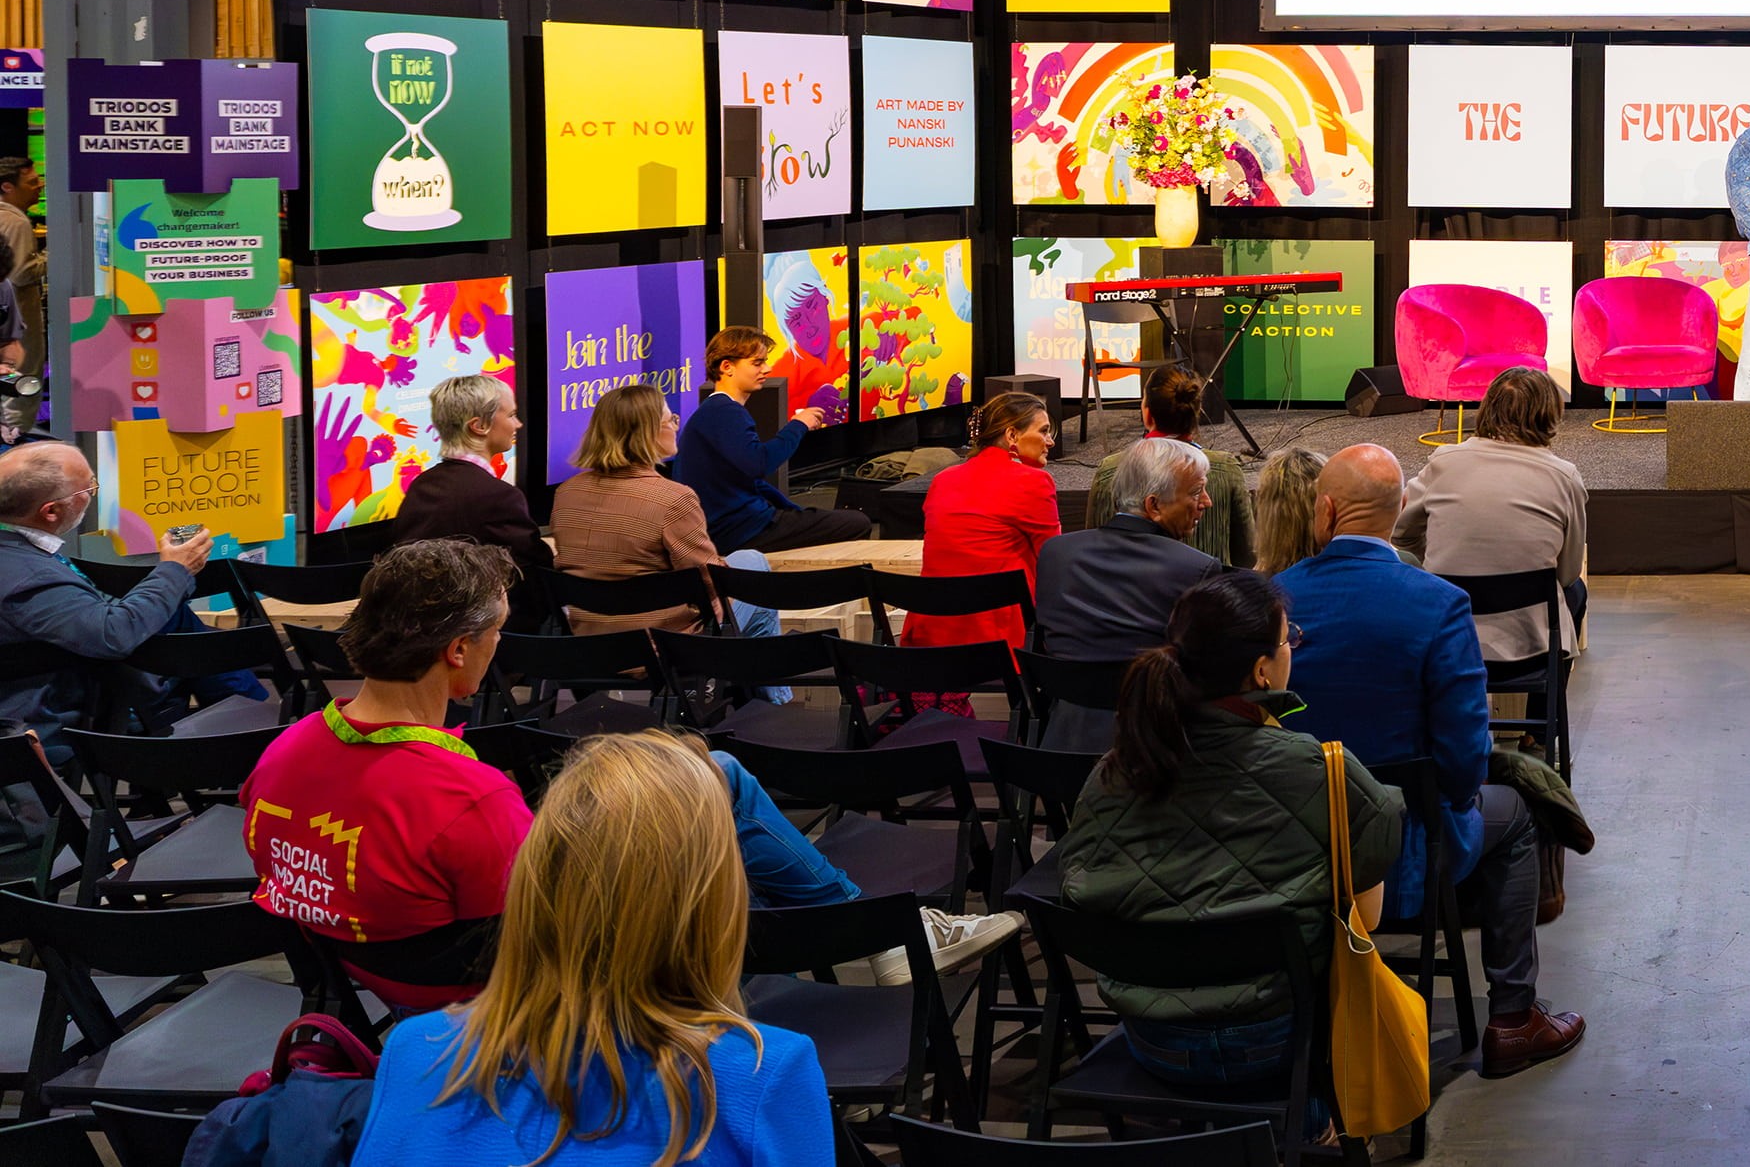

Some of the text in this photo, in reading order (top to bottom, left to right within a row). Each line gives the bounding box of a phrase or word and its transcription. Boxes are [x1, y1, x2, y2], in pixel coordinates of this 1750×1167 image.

[390, 53, 433, 76] if not
[742, 71, 823, 105] Let's
[95, 101, 172, 114] TRIODOS
[222, 102, 278, 114] TRIODOS
[876, 99, 965, 112] ART MADE BY
[109, 120, 159, 132] BANK
[233, 121, 268, 132] BANK
[560, 120, 694, 137] ACT NOW
[897, 118, 946, 130] NANSKI
[1458, 103, 1521, 141] THE
[1621, 103, 1750, 142] FUTURE
[84, 138, 184, 151] MAINSTAGE
[214, 138, 286, 151] MAINSTAGE
[888, 136, 955, 149] PUNANSKI
[762, 118, 842, 200] row
[383, 174, 445, 198] when?
[172, 209, 225, 218] Welcome
[157, 221, 240, 232] changemaker!
[139, 238, 258, 249] DISCOVER HOW TO
[151, 254, 247, 264] FUTURE-PROOF
[150, 269, 249, 280] YOUR BUSINESS
[1095, 290, 1120, 301] nord
[231, 309, 274, 320] FOLLOW US
[1251, 326, 1334, 337] ACTION
[560, 323, 653, 371] Join the
[143, 448, 261, 477] FUTURE
[143, 471, 260, 500] PROOF
[143, 494, 261, 515] CONVENTION
[270, 837, 333, 881] SOCIAL
[271, 861, 335, 905] IMPACT
[267, 879, 340, 926] FACTORY
